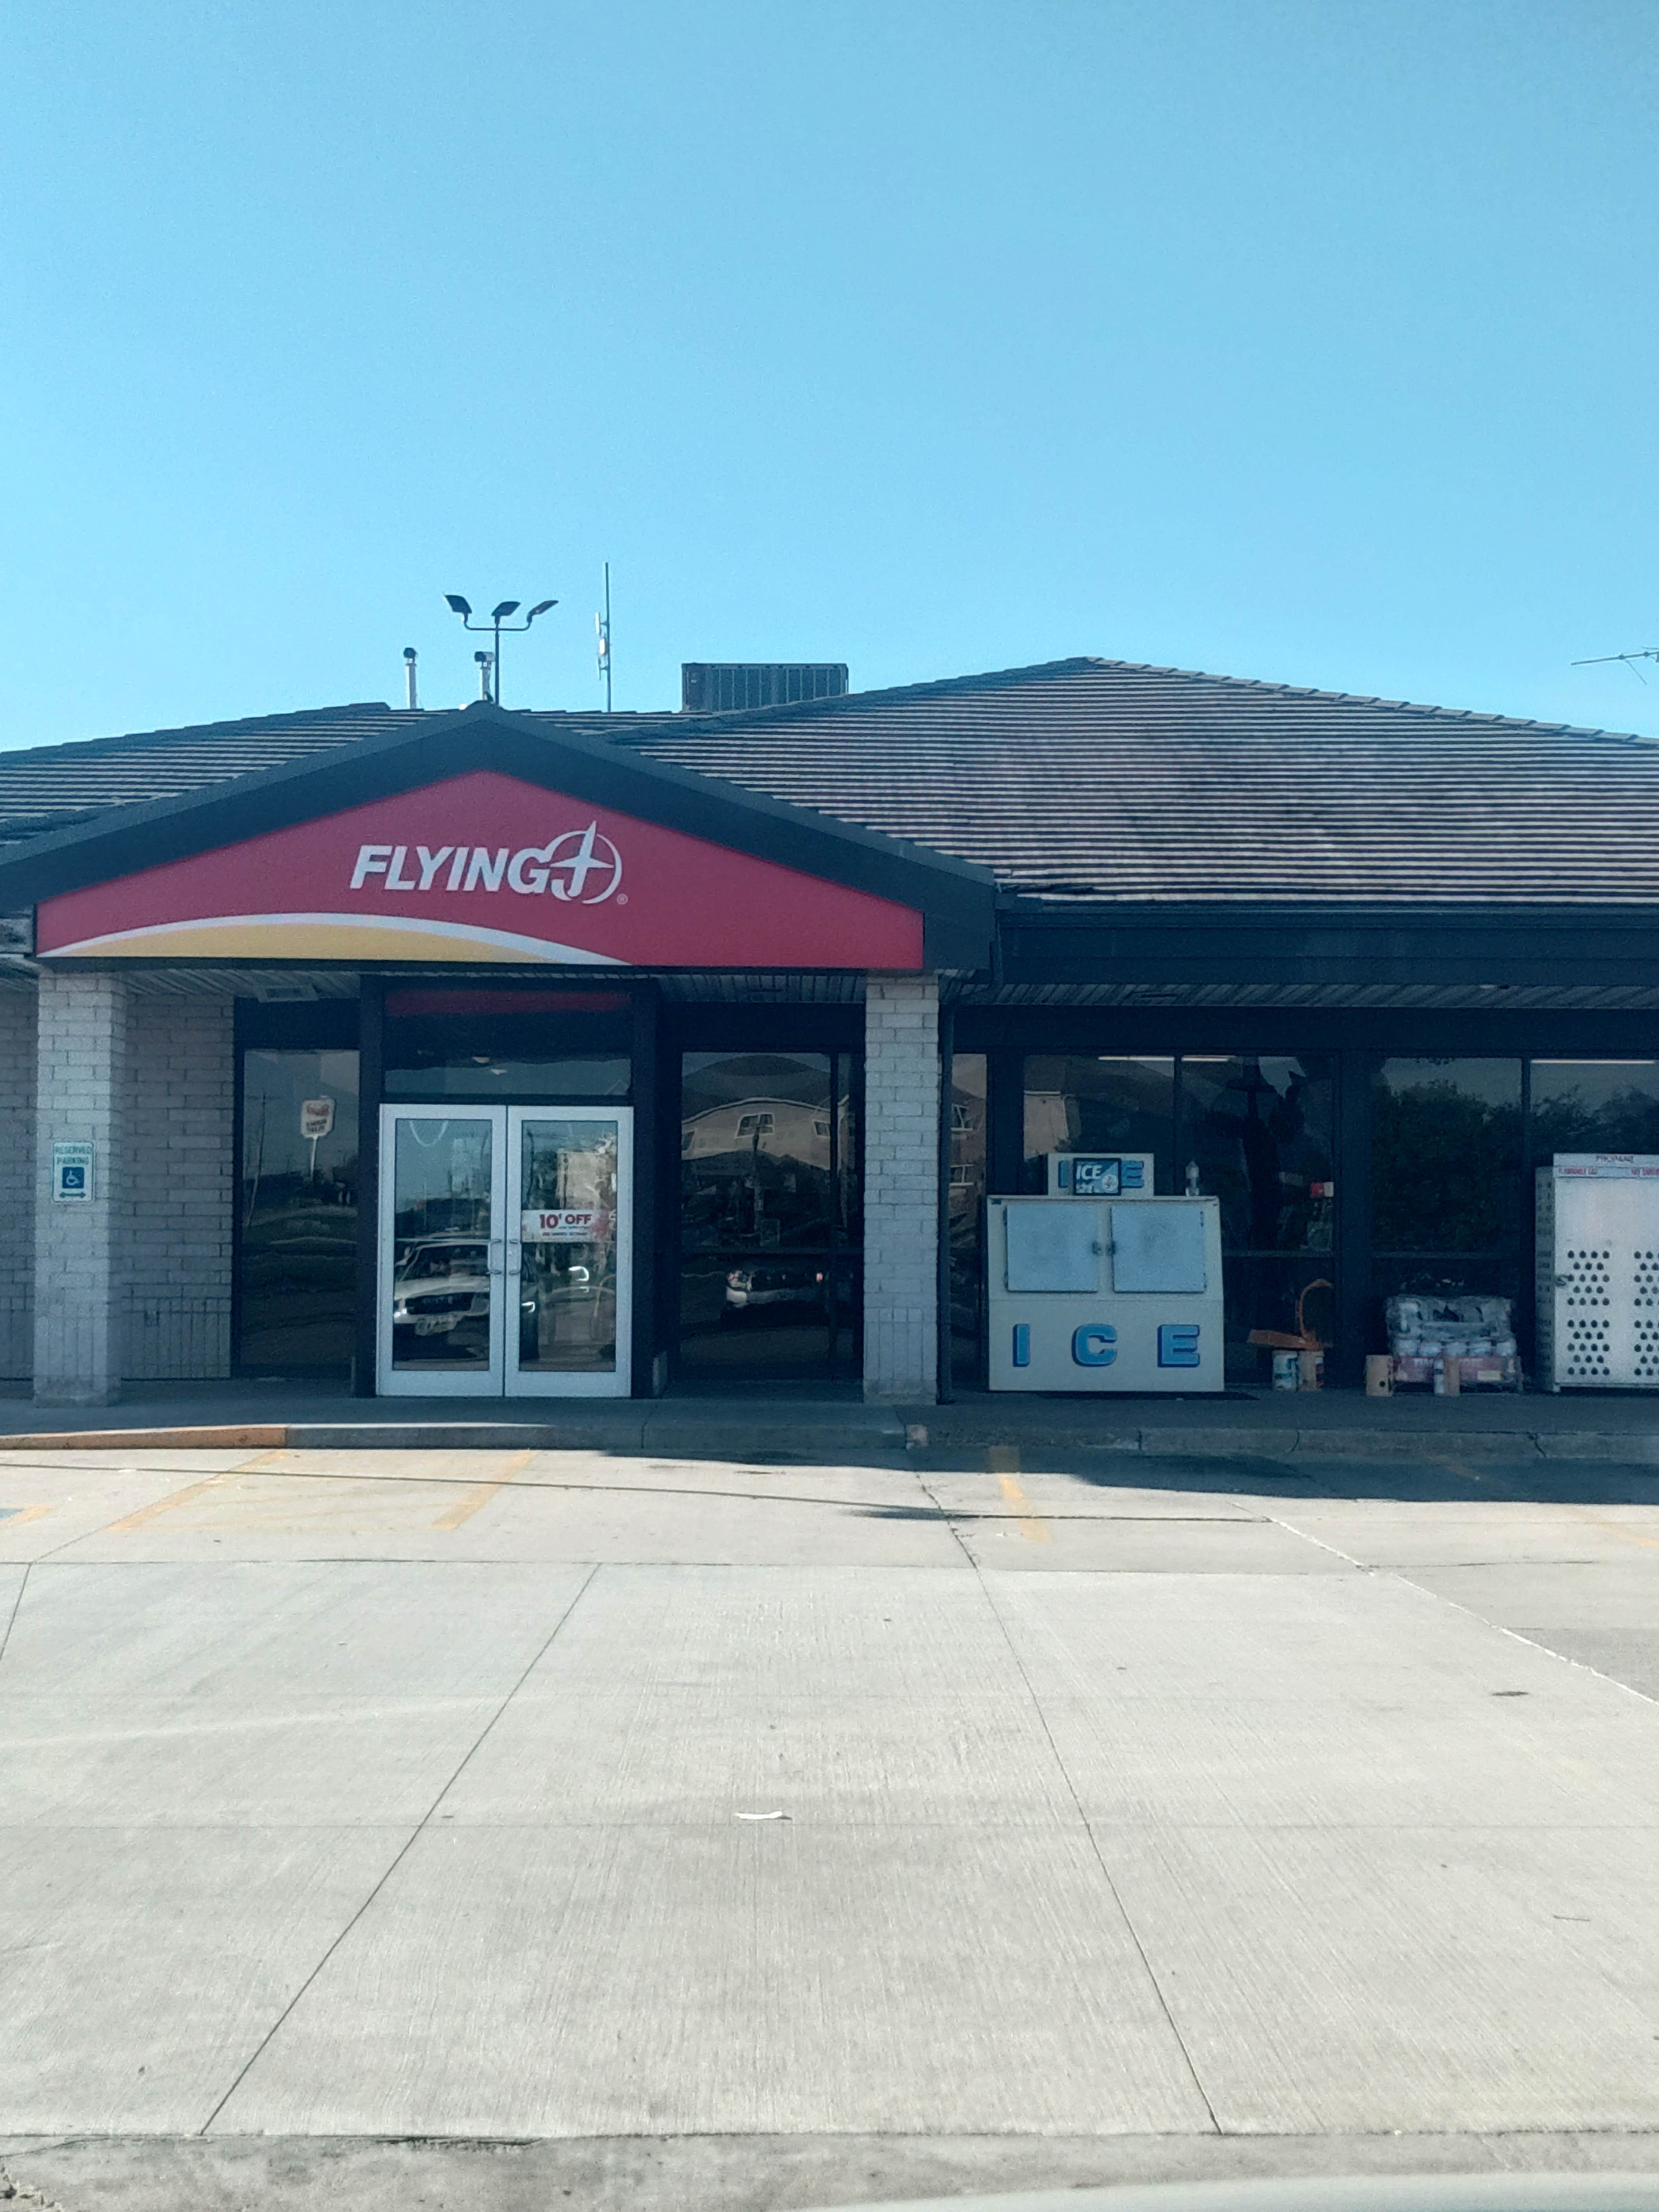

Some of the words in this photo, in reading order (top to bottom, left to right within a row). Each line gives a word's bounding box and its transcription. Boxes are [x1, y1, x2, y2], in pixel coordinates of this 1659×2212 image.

[350, 845, 549, 894] FLYING
[1076, 1165, 1102, 1180] ICE
[565, 1214, 592, 1225] OFF
